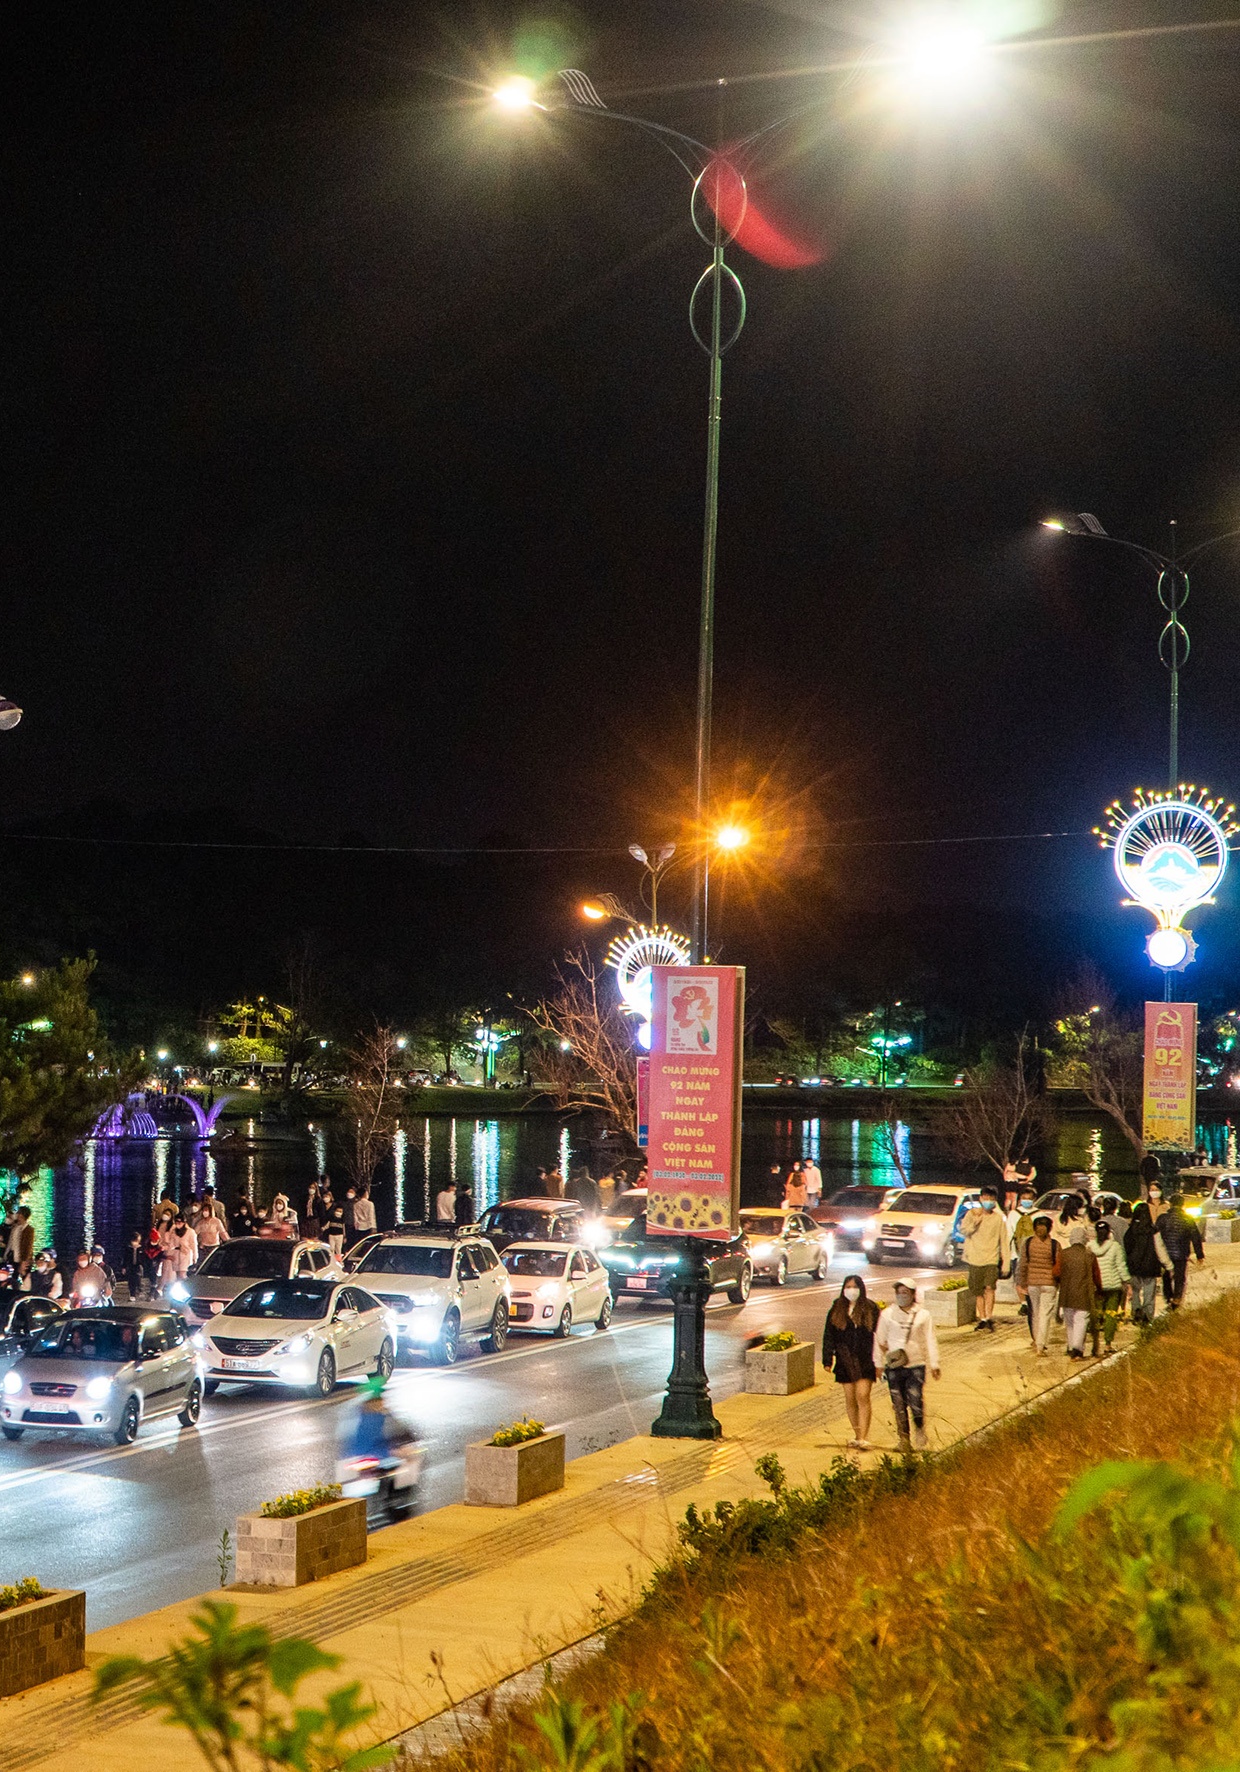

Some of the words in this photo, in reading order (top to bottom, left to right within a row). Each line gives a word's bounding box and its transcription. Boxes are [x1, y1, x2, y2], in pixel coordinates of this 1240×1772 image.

[1155, 1048, 1182, 1066] 92
[670, 1081, 683, 1090] 92
[688, 1159, 713, 1169] NAM
